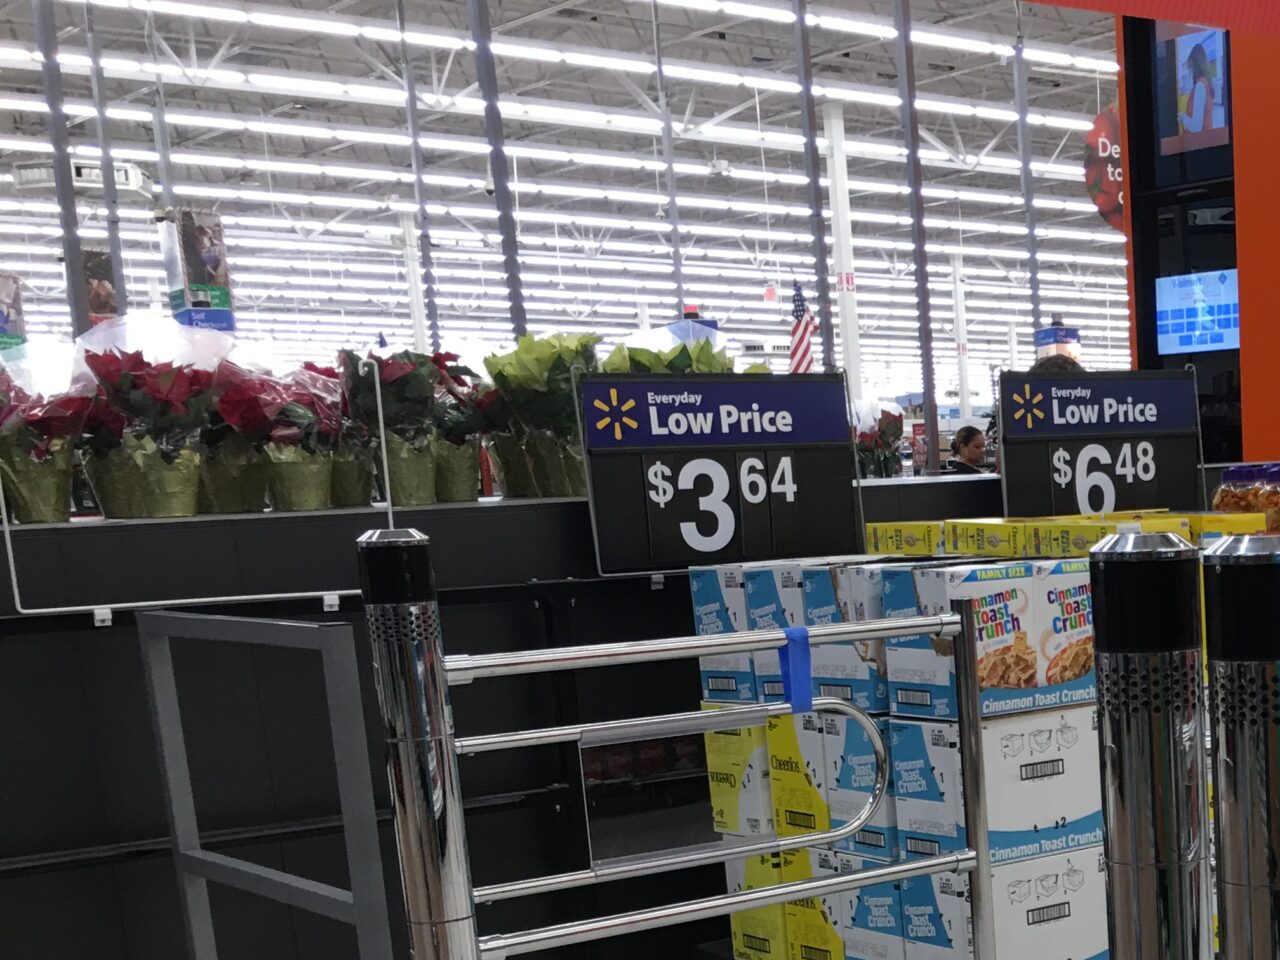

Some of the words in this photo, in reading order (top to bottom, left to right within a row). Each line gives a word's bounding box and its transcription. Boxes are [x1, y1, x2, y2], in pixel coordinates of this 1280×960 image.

[647, 392, 702, 406] Everyday
[1051, 386, 1091, 398] Everyday
[1052, 399, 1099, 425] Low
[1103, 396, 1158, 424] Price
[649, 406, 714, 435] Low
[718, 403, 793, 434] Price
[976, 569, 1007, 580] FAMILY
[1008, 567, 1026, 579] SIZE
[972, 587, 1019, 609] nnamon
[807, 604, 837, 619] Cinnamon
[975, 613, 1021, 643] runch
[1052, 610, 1092, 635] Crunc
[982, 695, 1033, 714] Cinnamon
[1034, 691, 1060, 706] Toast
[1061, 684, 1096, 702] Crunch
[770, 754, 802, 774] Cheerios
[894, 759, 925, 771] Cinnamon
[900, 768, 920, 782] Toast
[898, 776, 928, 794] Crunch
[1060, 816, 1067, 828] 2
[988, 842, 1040, 861] Cinnamon
[1040, 835, 1067, 851] Toast
[1068, 828, 1103, 847] Crunch
[864, 894, 894, 906] Cinnamon
[870, 905, 890, 918] Toast
[904, 904, 934, 915] Cinnamon
[867, 913, 896, 928] Crunch
[910, 914, 931, 927] Toast
[907, 925, 937, 938] Crunch
